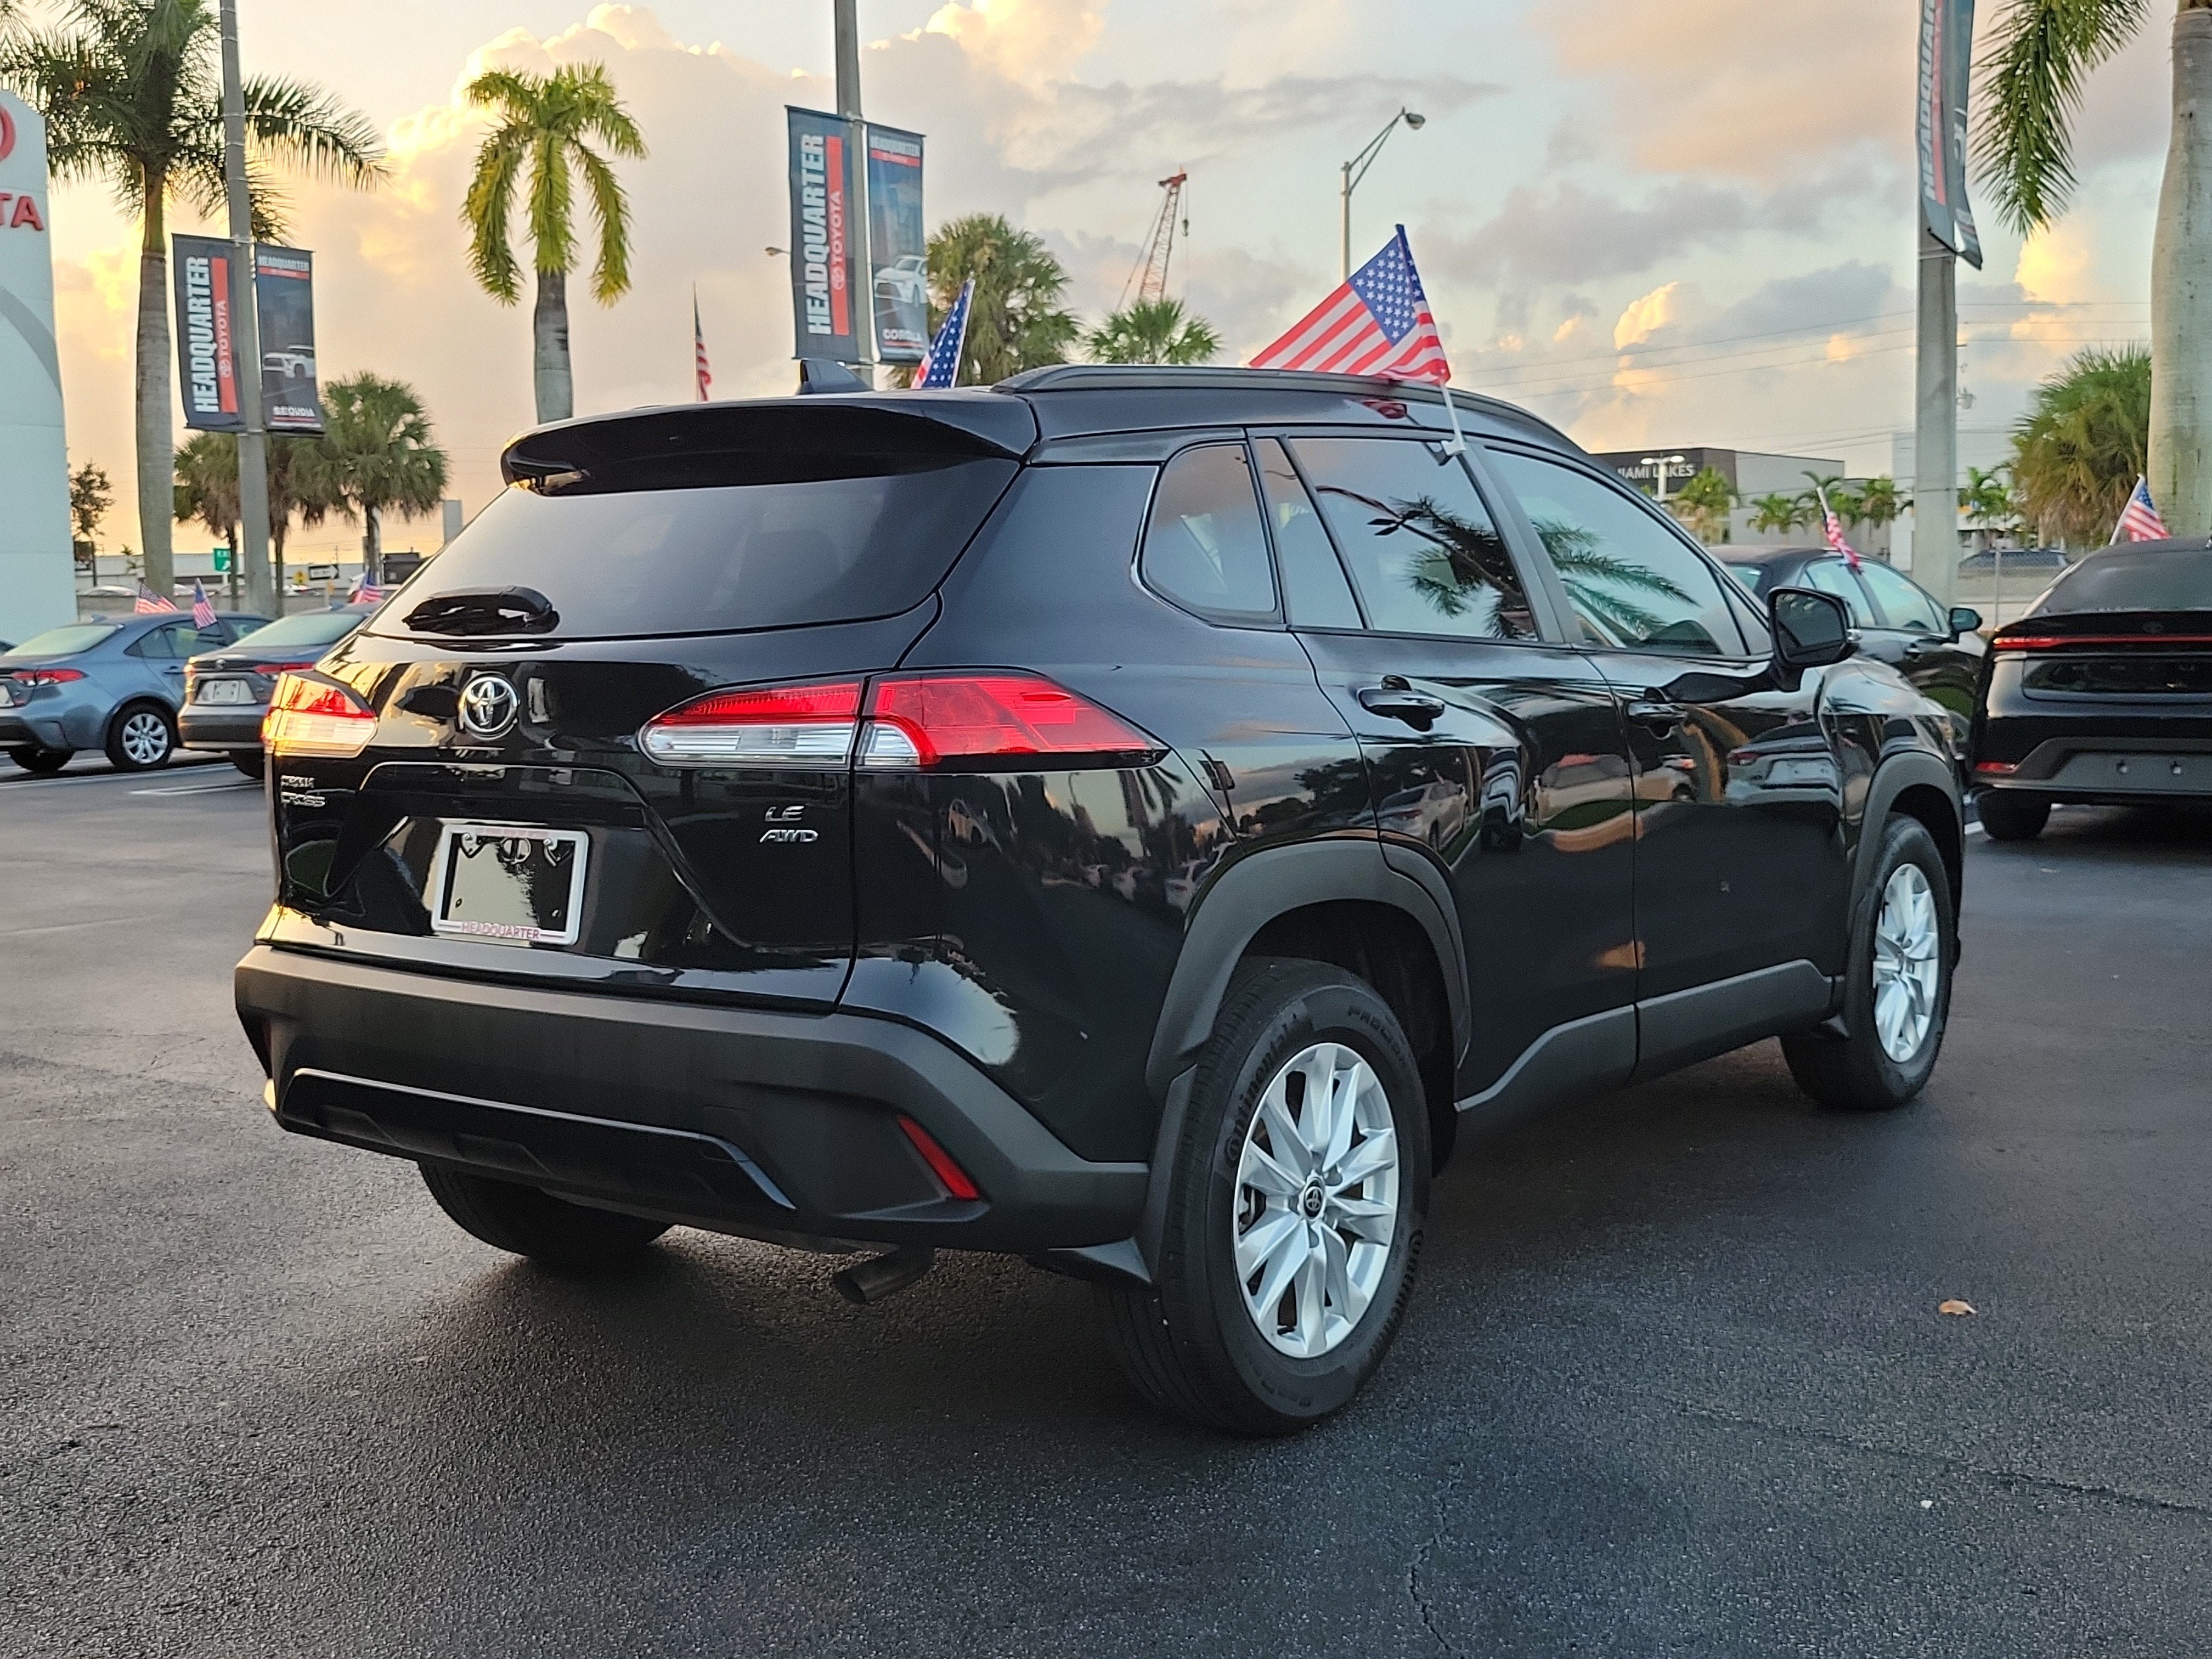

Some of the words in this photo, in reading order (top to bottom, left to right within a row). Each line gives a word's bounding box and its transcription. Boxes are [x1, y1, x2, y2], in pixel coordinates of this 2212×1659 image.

[800, 134, 832, 335] HEADQUARTER
[830, 190, 844, 265] TOYOTA
[186, 256, 220, 413] HEADQUARTER
[216, 300, 232, 357] TOYOTA
[759, 829, 819, 843] AWD
[765, 805, 805, 822] LE
[461, 922, 540, 940] HEADQUARTER
